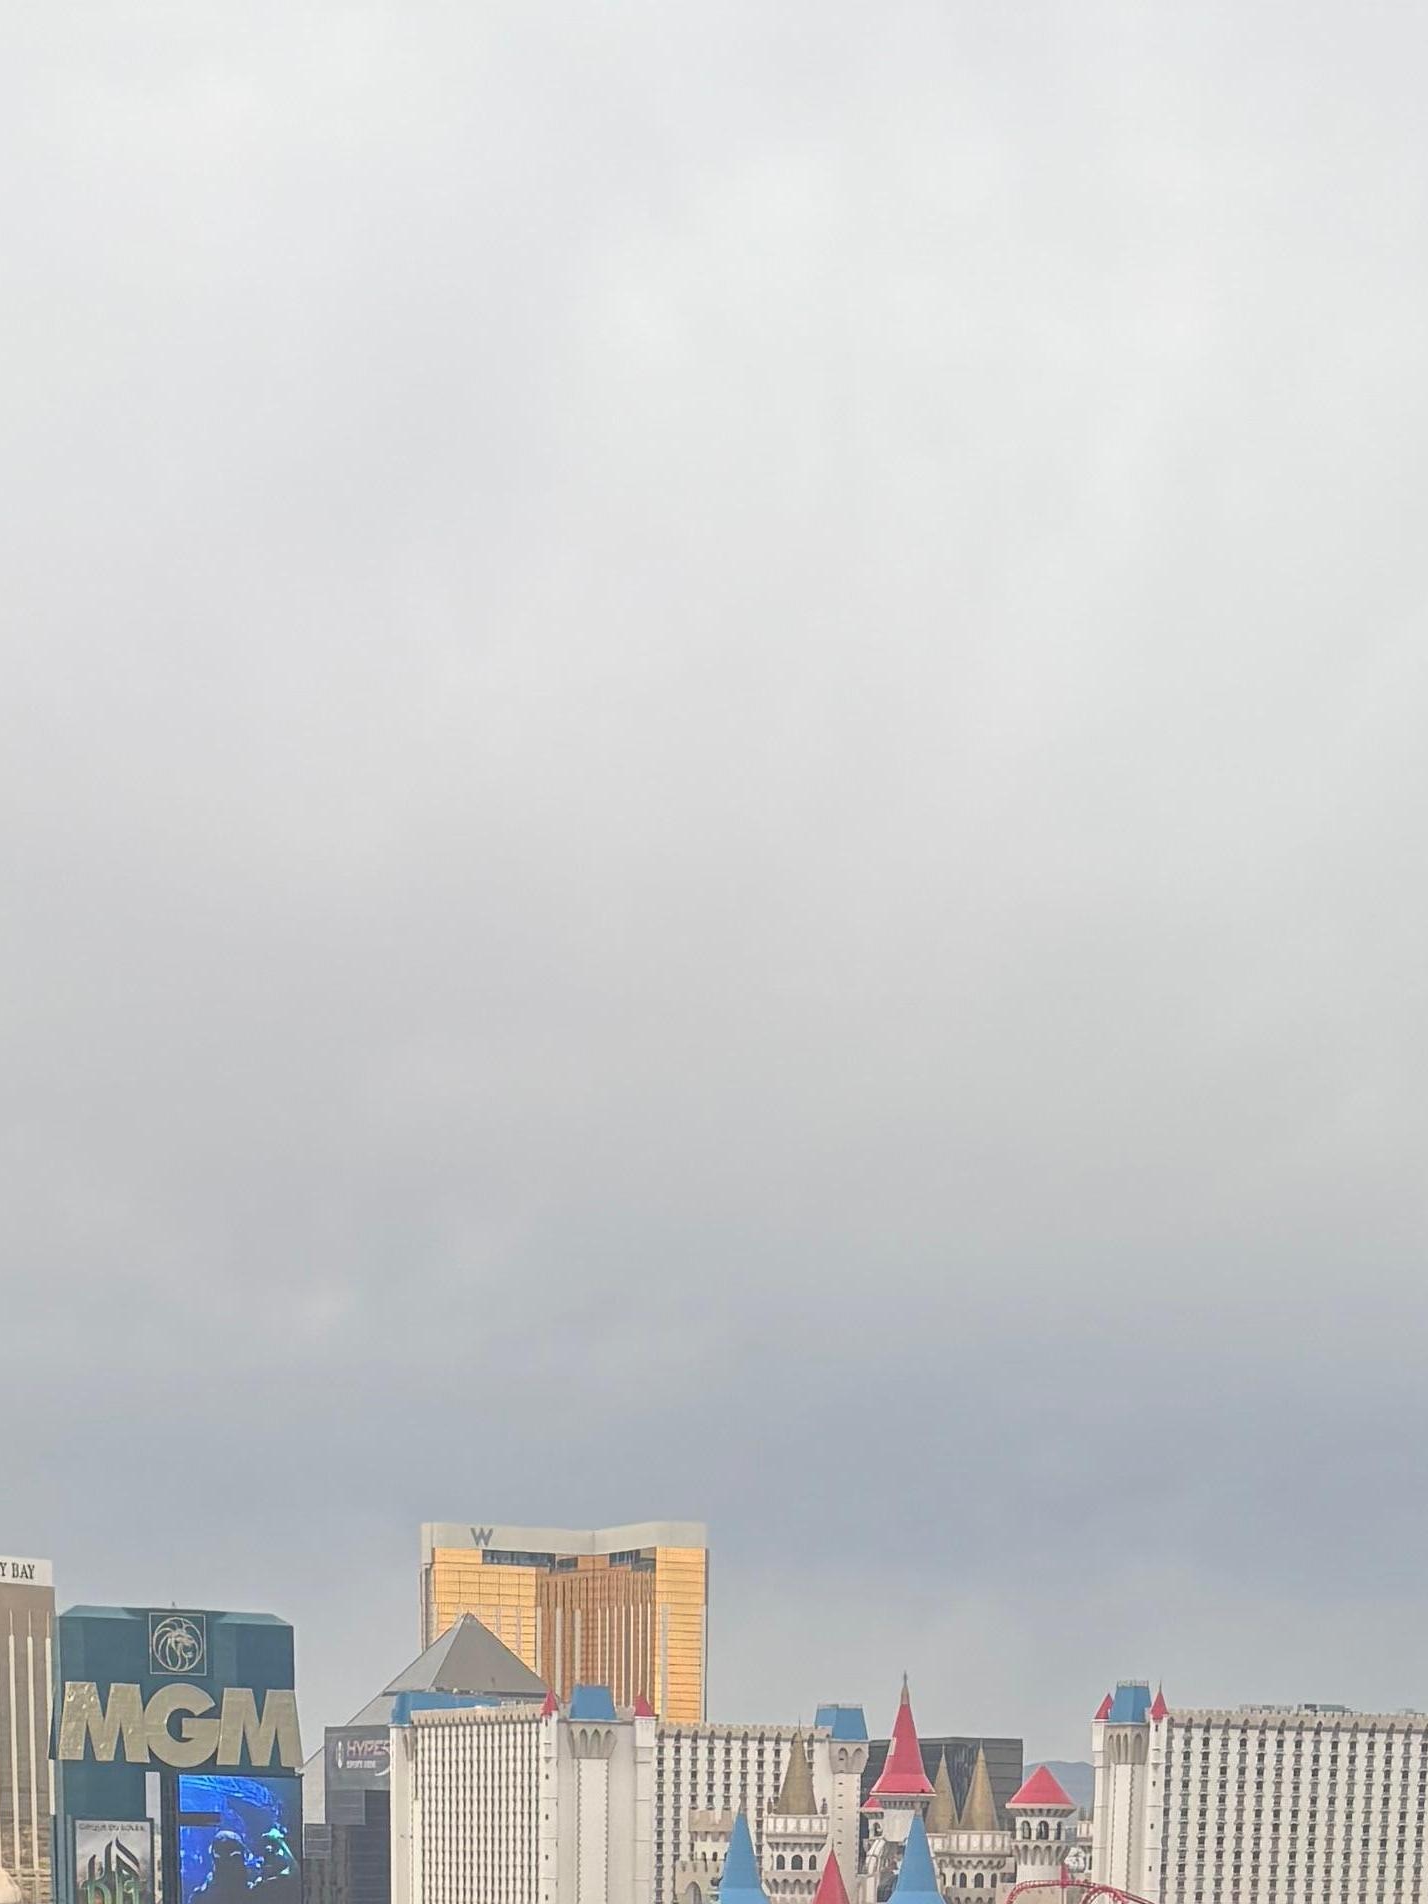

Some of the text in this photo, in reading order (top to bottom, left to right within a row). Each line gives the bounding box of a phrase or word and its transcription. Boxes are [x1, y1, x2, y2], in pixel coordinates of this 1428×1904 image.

[470, 1528, 493, 1546] W
[12, 1562, 36, 1580] BAY
[58, 1681, 304, 1768] MGM
